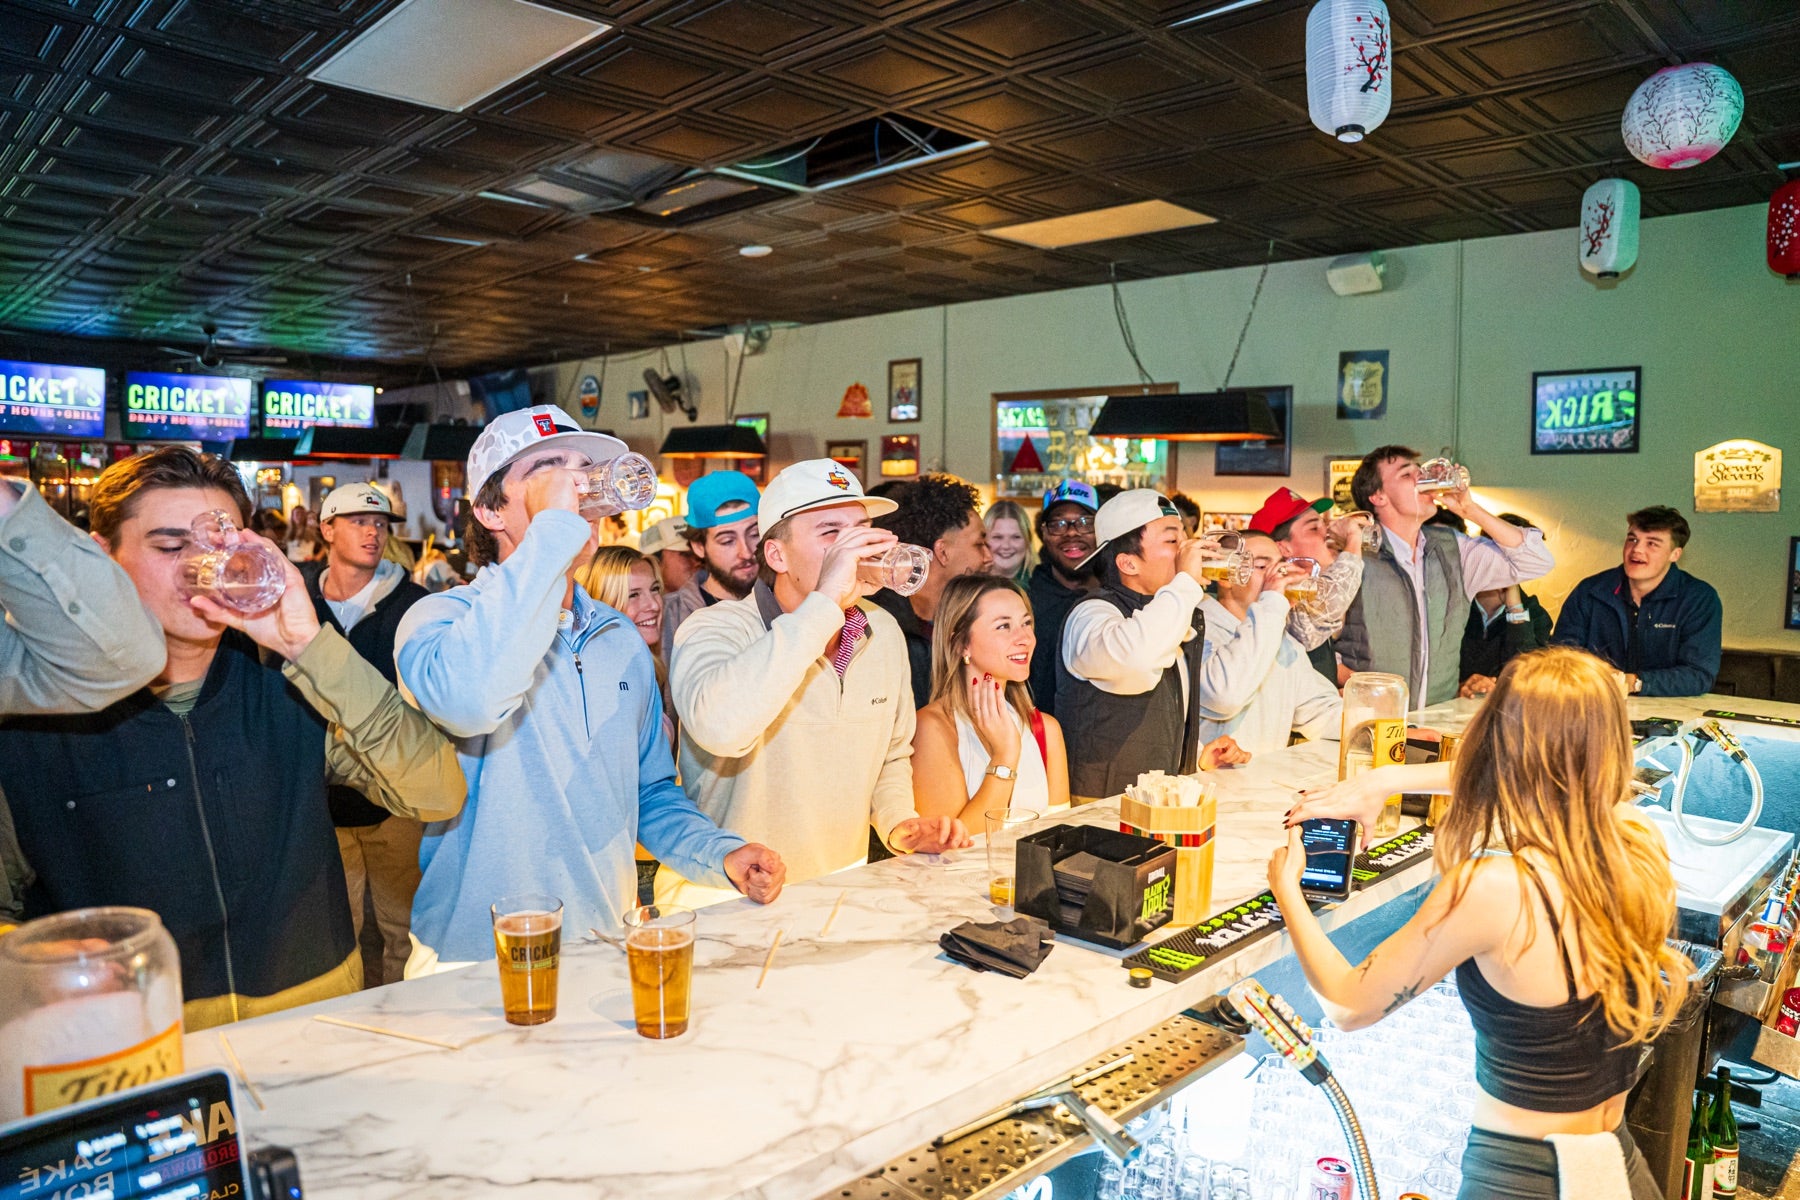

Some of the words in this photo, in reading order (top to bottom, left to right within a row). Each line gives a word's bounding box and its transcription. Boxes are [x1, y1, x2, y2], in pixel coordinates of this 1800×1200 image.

[128, 384, 247, 415] CRICKET'S
[11, 406, 54, 417] HOUSE
[63, 409, 101, 421] GRILL
[128, 413, 167, 424] DRAFT
[170, 415, 208, 426] HOUSE
[1711, 463, 1762, 473] Dewey
[1706, 471, 1764, 485] Stevens
[1141, 890, 1168, 920] APPLE
